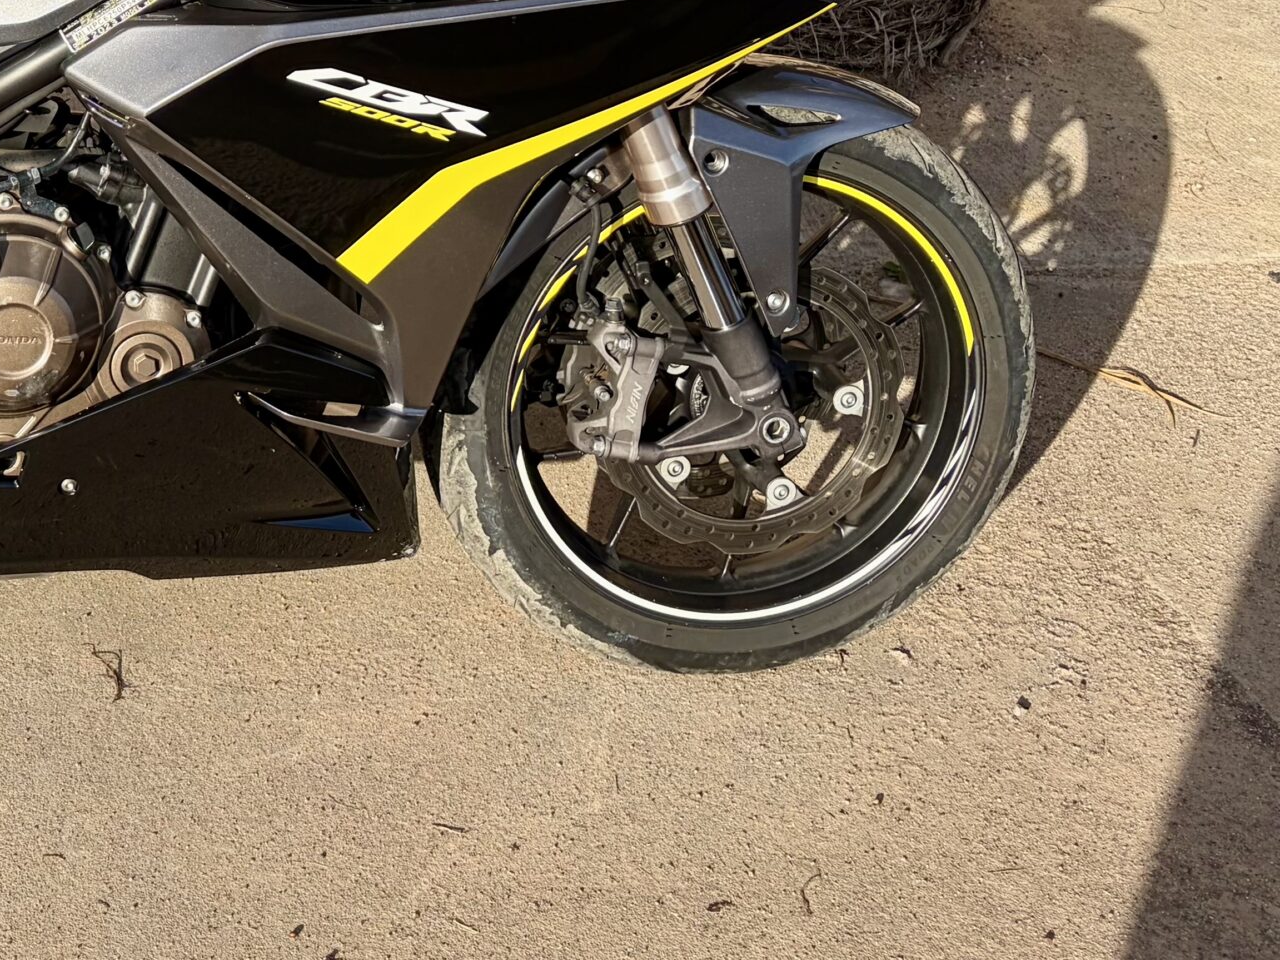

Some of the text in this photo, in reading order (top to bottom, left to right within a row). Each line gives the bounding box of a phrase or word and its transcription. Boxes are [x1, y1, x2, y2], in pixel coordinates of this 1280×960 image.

[90, 17, 119, 39] 2023
[285, 67, 489, 137] CBR
[318, 95, 457, 142] 500R
